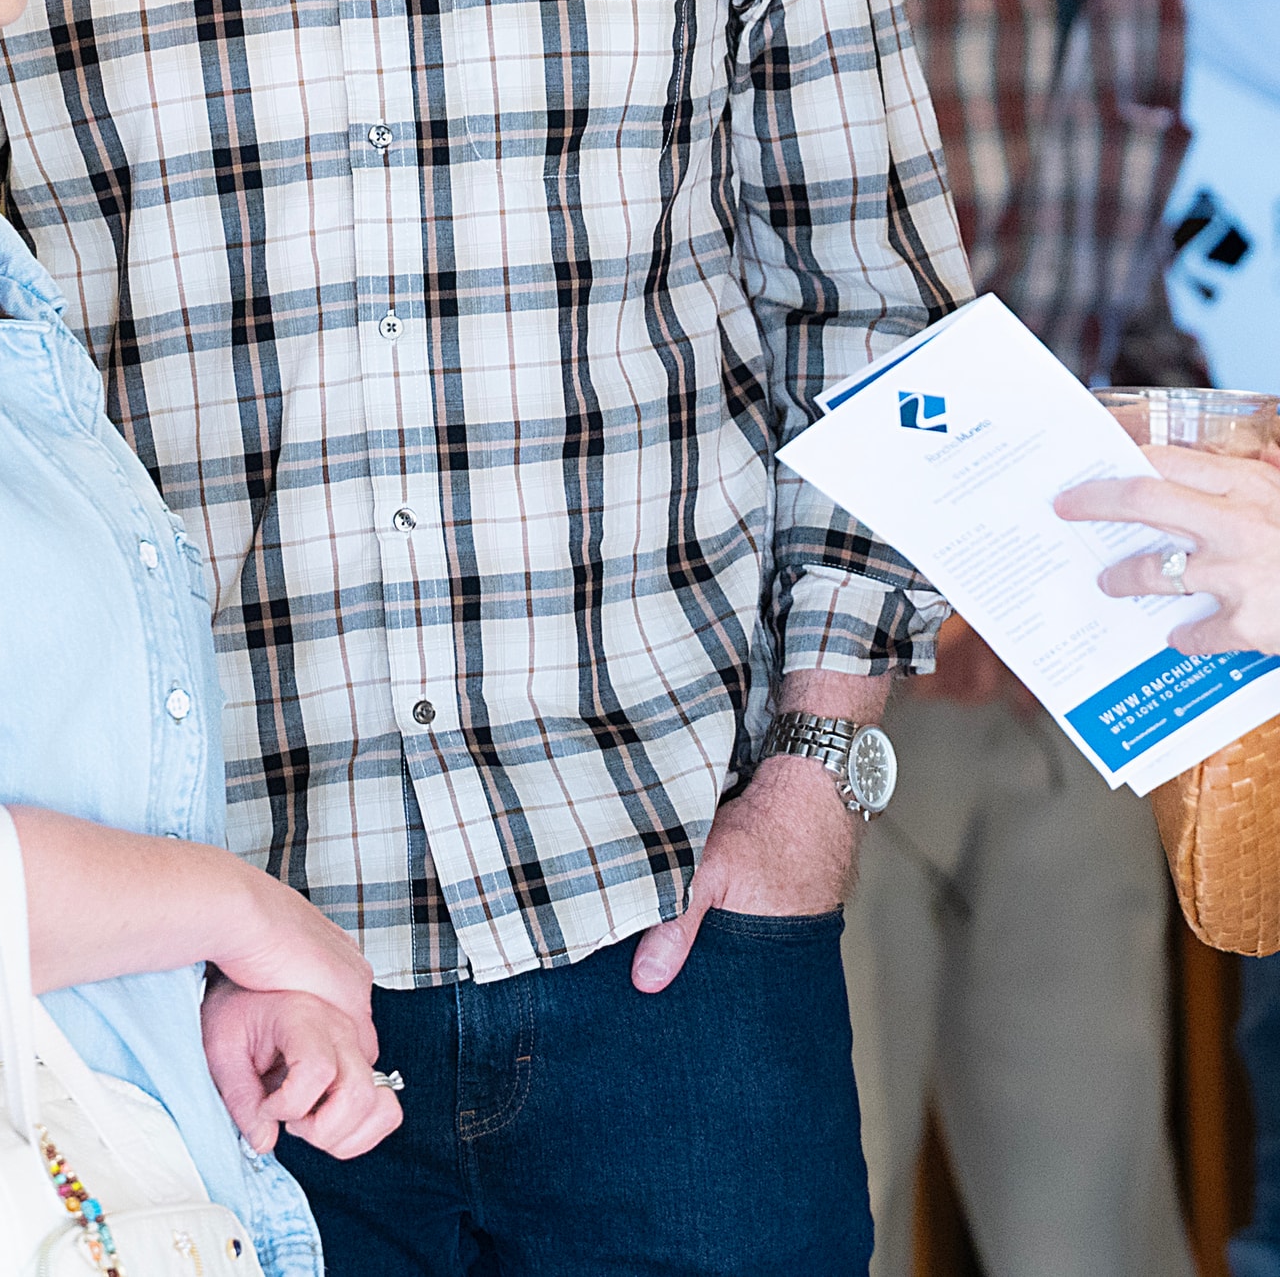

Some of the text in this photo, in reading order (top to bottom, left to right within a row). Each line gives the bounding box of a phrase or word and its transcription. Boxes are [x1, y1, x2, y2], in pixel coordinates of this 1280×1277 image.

[1110, 715, 1136, 734] WE'D
[1135, 698, 1160, 718] LOVE
[1159, 689, 1174, 702] TO
[1173, 662, 1217, 693] CONNECT
